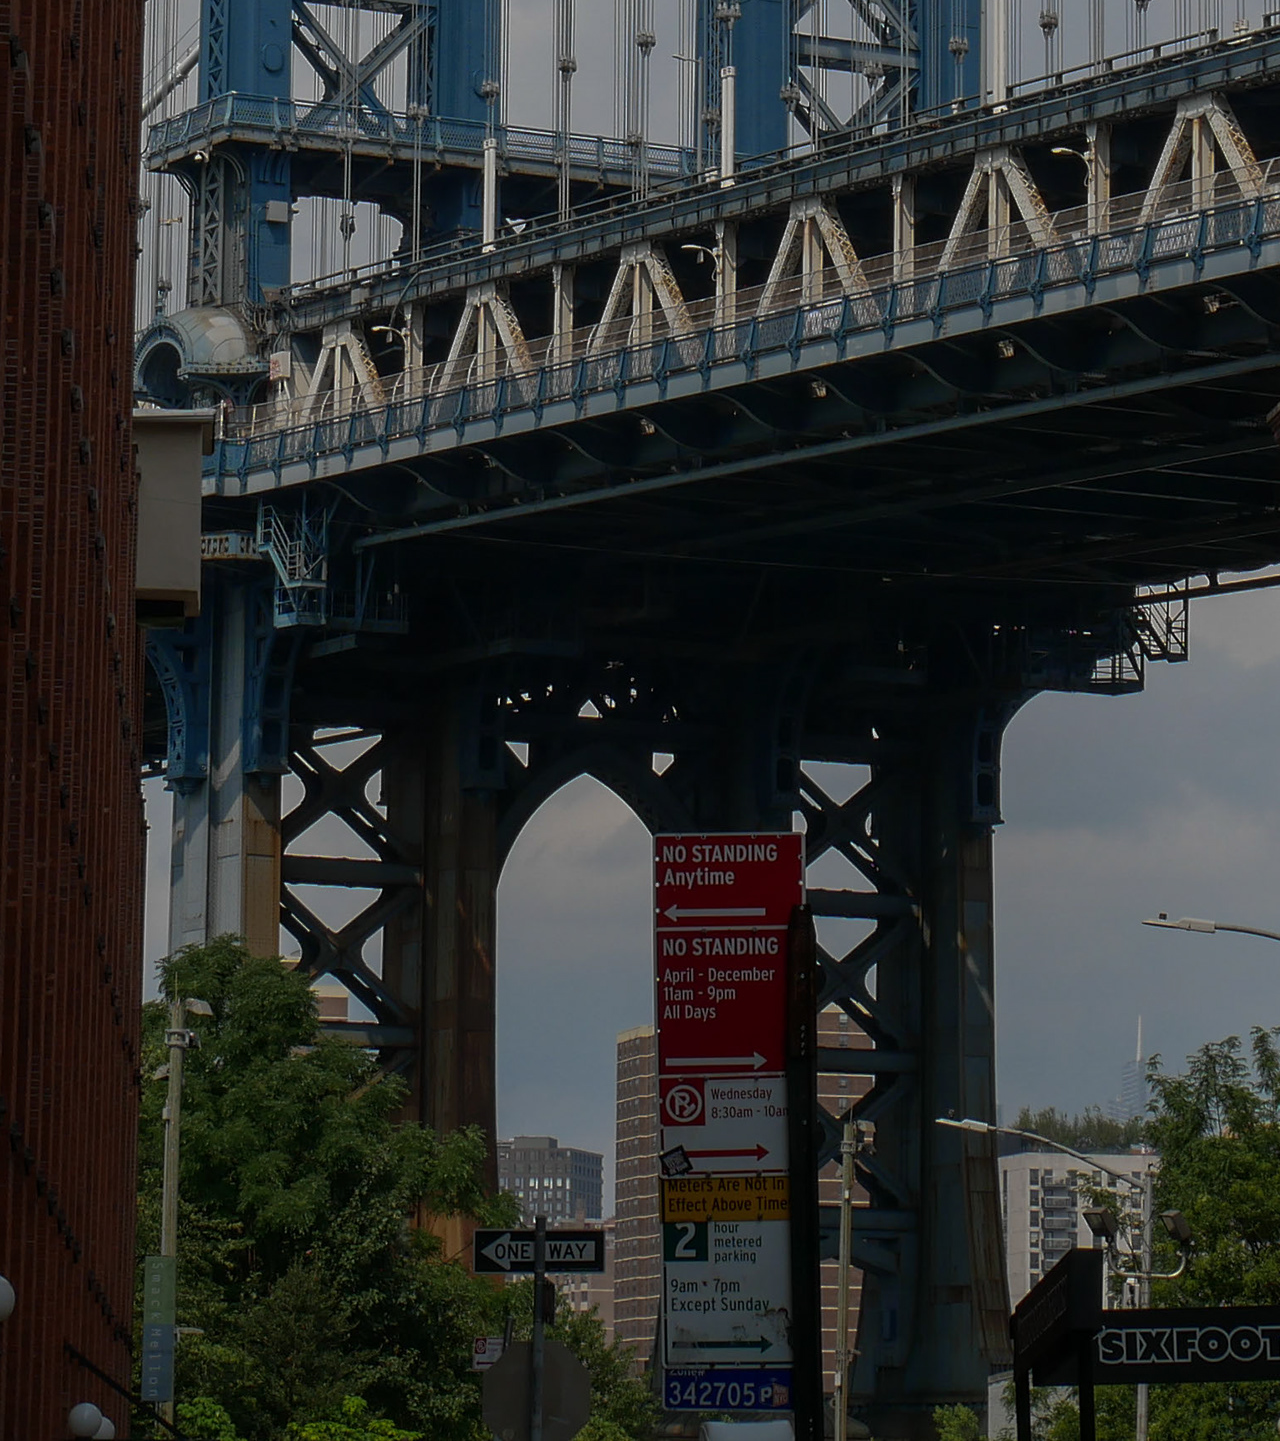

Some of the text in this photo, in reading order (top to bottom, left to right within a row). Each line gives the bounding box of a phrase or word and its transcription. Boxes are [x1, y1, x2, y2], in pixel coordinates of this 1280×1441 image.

[663, 843, 778, 863] NO STANDING
[663, 868, 735, 889] Anytime
[663, 937, 779, 957] NO STANDING
[663, 967, 694, 985] April
[708, 967, 775, 982] December
[663, 987, 694, 1001] 11am
[707, 986, 736, 1004] 9pm
[663, 1005, 717, 1022] All Days
[711, 1087, 772, 1101] Wednesday
[711, 1106, 753, 1118] 8:30am
[668, 1177, 784, 1193] Meters Are Not In
[669, 1197, 707, 1212] Effect
[712, 1197, 751, 1211] Above
[714, 1222, 739, 1233] hour
[674, 1222, 697, 1258] 2
[714, 1236, 762, 1248] metered
[495, 1243, 587, 1259] ONE WAY
[714, 1250, 757, 1263] parking
[151, 1262, 164, 1321] Smack
[671, 1279, 698, 1293] 9am
[713, 1279, 740, 1295] 7pm
[671, 1297, 769, 1313] Except Sunday
[668, 1381, 756, 1407] 342705
